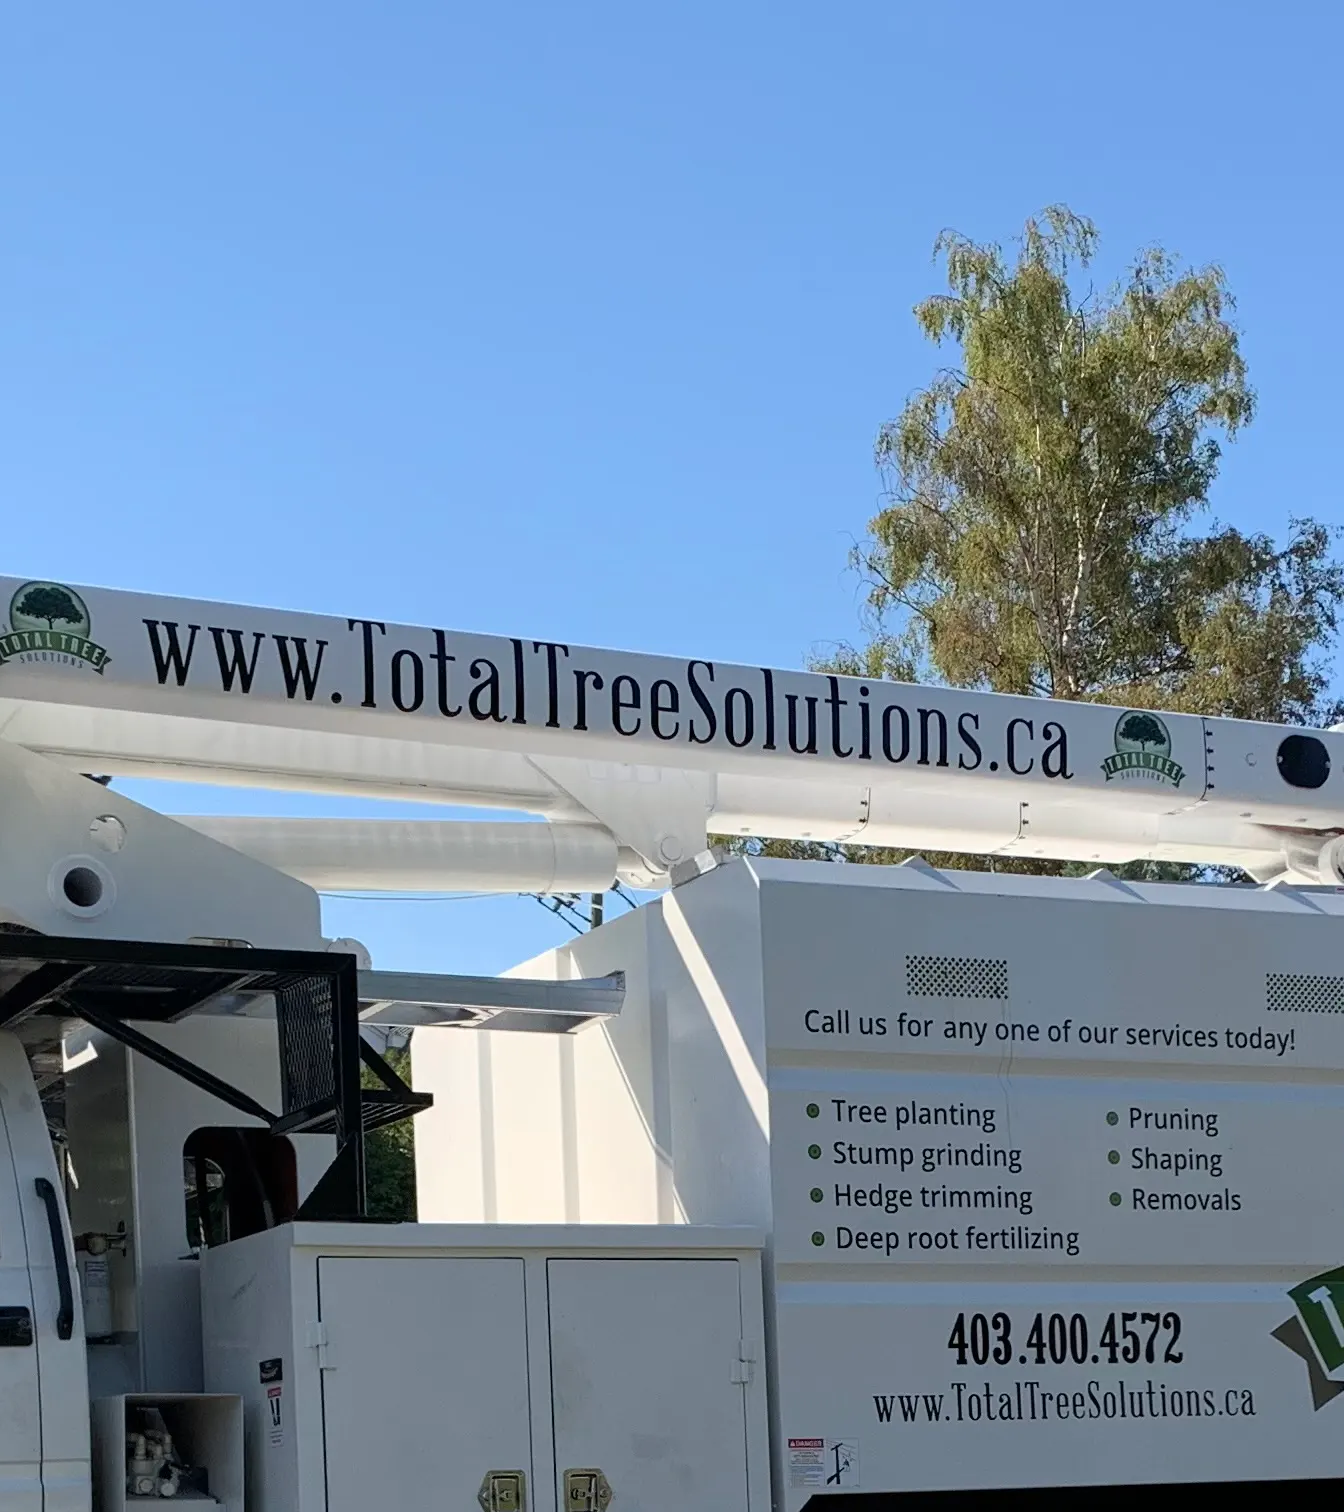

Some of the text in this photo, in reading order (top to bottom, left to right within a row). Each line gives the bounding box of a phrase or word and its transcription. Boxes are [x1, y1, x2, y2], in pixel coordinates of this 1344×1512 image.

[0, 631, 103, 663] TOTAL TREE
[19, 651, 85, 669] SOLUTIONS
[141, 617, 1075, 781] www.TotalTreeSolutions.ca
[1107, 752, 1180, 779] TOTAL TREE
[804, 1009, 1296, 1057] Call us for any one of our services today!
[831, 1099, 997, 1134] Tree planting
[1129, 1107, 1219, 1138] Pruning
[833, 1141, 1023, 1174] Stump grinding
[1131, 1146, 1223, 1178] Shaping
[834, 1183, 1034, 1216] Hedge trimming
[1132, 1187, 1242, 1211] Removals
[836, 1225, 1081, 1257] Deep root fertilizing
[947, 1311, 1184, 1366] 403.400.4572
[872, 1380, 1257, 1423] www.TotalTreeSolutions.ca
